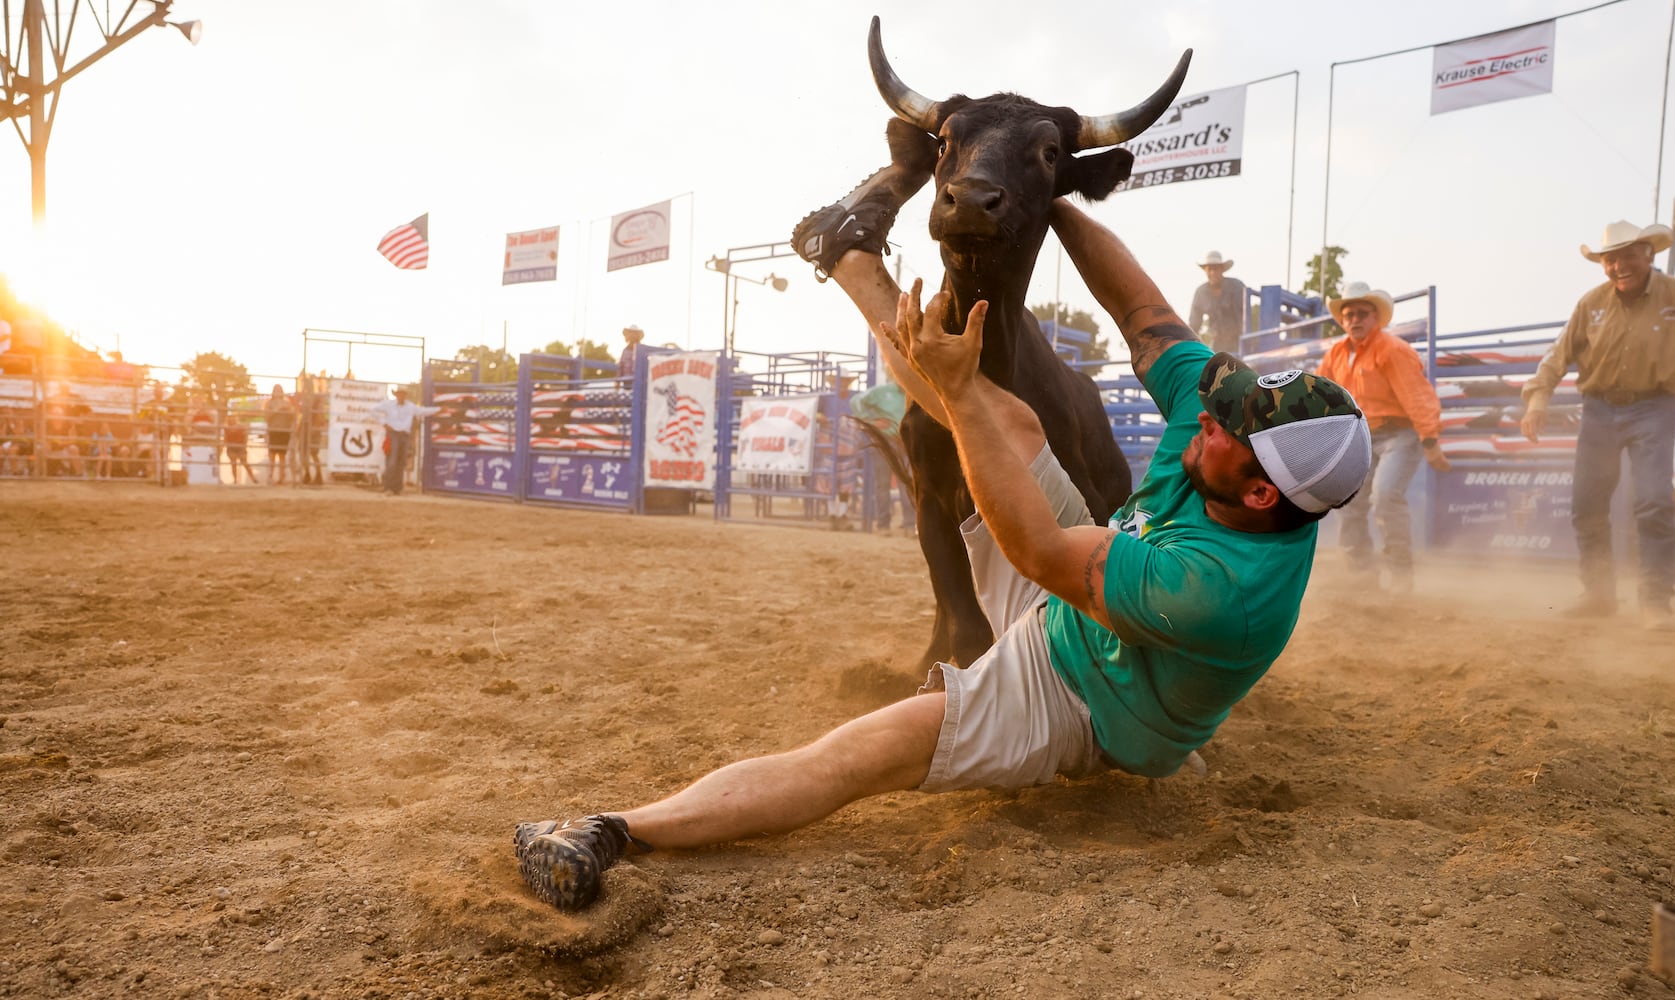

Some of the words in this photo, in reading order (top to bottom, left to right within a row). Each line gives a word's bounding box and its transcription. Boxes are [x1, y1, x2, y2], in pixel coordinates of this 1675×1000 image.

[1435, 64, 1485, 84] Krause
[1490, 52, 1548, 73] Electric
[1117, 123, 1232, 157] ussard's
[1135, 147, 1209, 167] LAUGHTERHOUSE
[581, 463, 594, 494] 2
[1464, 472, 1530, 486] BROKEN
[1490, 534, 1551, 549] RODEO
